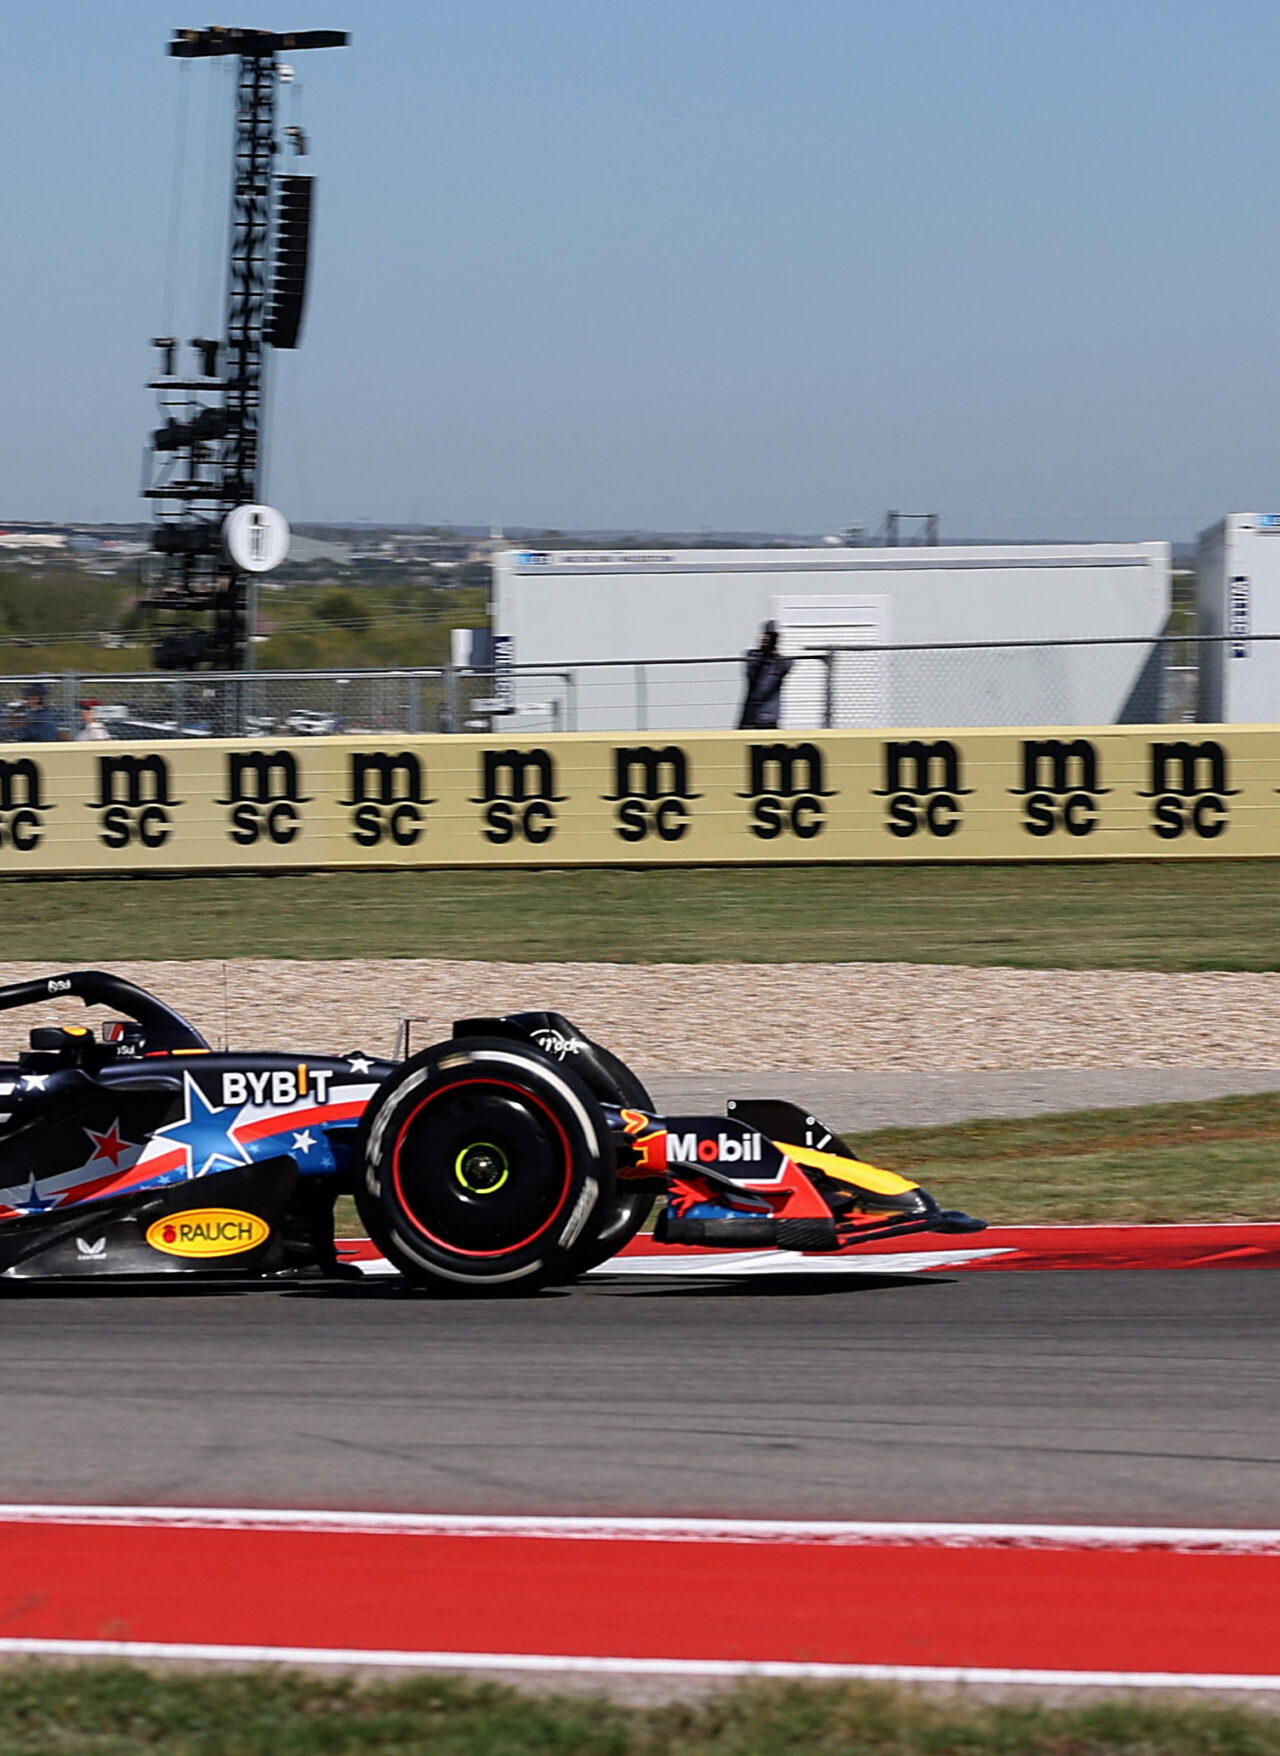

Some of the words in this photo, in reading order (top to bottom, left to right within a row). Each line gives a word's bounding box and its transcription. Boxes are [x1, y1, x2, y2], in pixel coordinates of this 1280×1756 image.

[222, 1063, 334, 1106] BYBIT
[666, 1132, 762, 1162] Mobil
[180, 1221, 253, 1243] RAUCH
